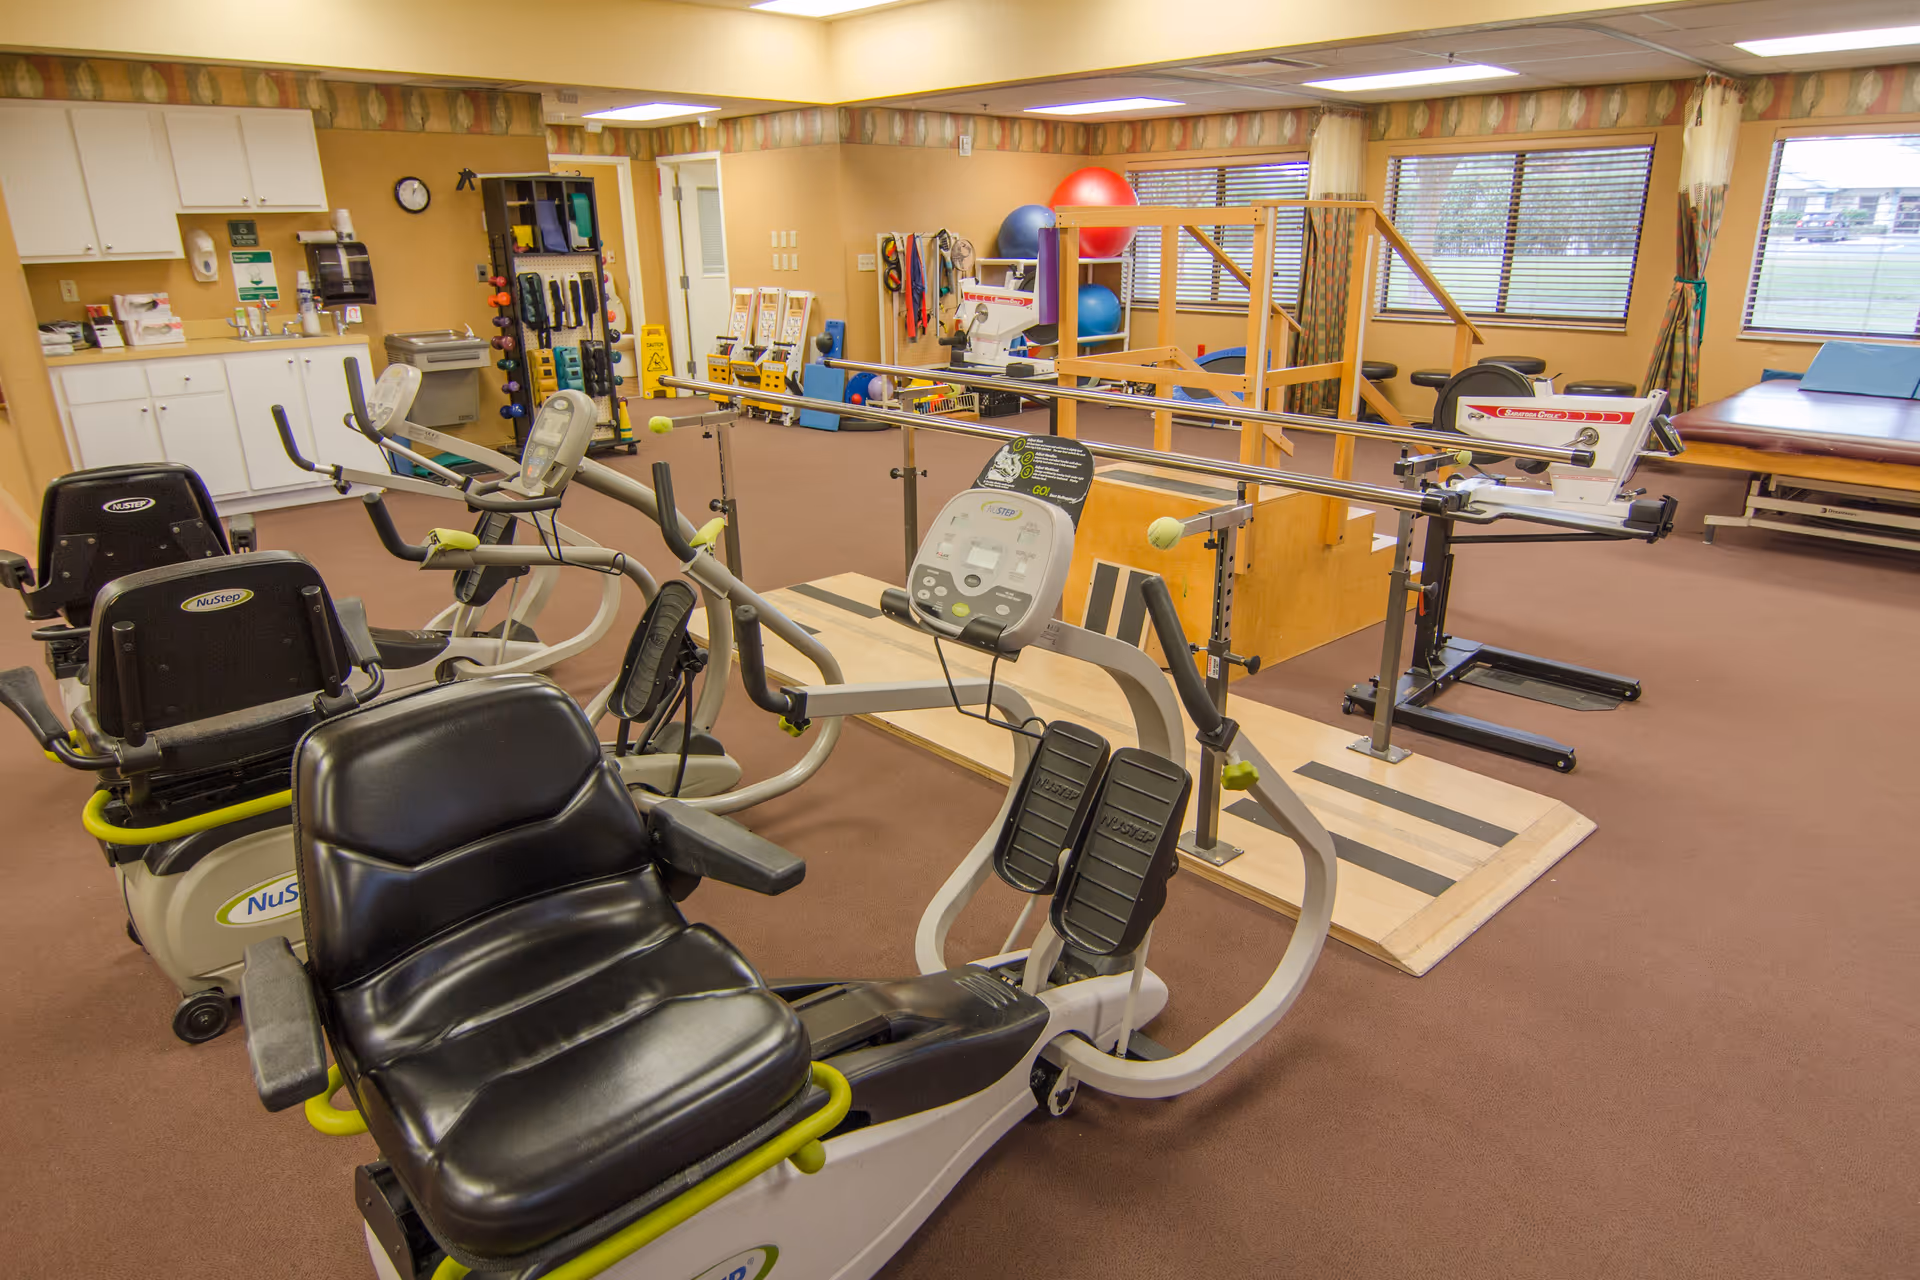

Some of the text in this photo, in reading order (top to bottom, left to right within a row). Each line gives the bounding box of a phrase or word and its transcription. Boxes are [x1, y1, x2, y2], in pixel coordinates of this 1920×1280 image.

[1032, 485, 1051, 497] GO!
[196, 593, 241, 607] NuStep
[247, 882, 299, 915] NuS
